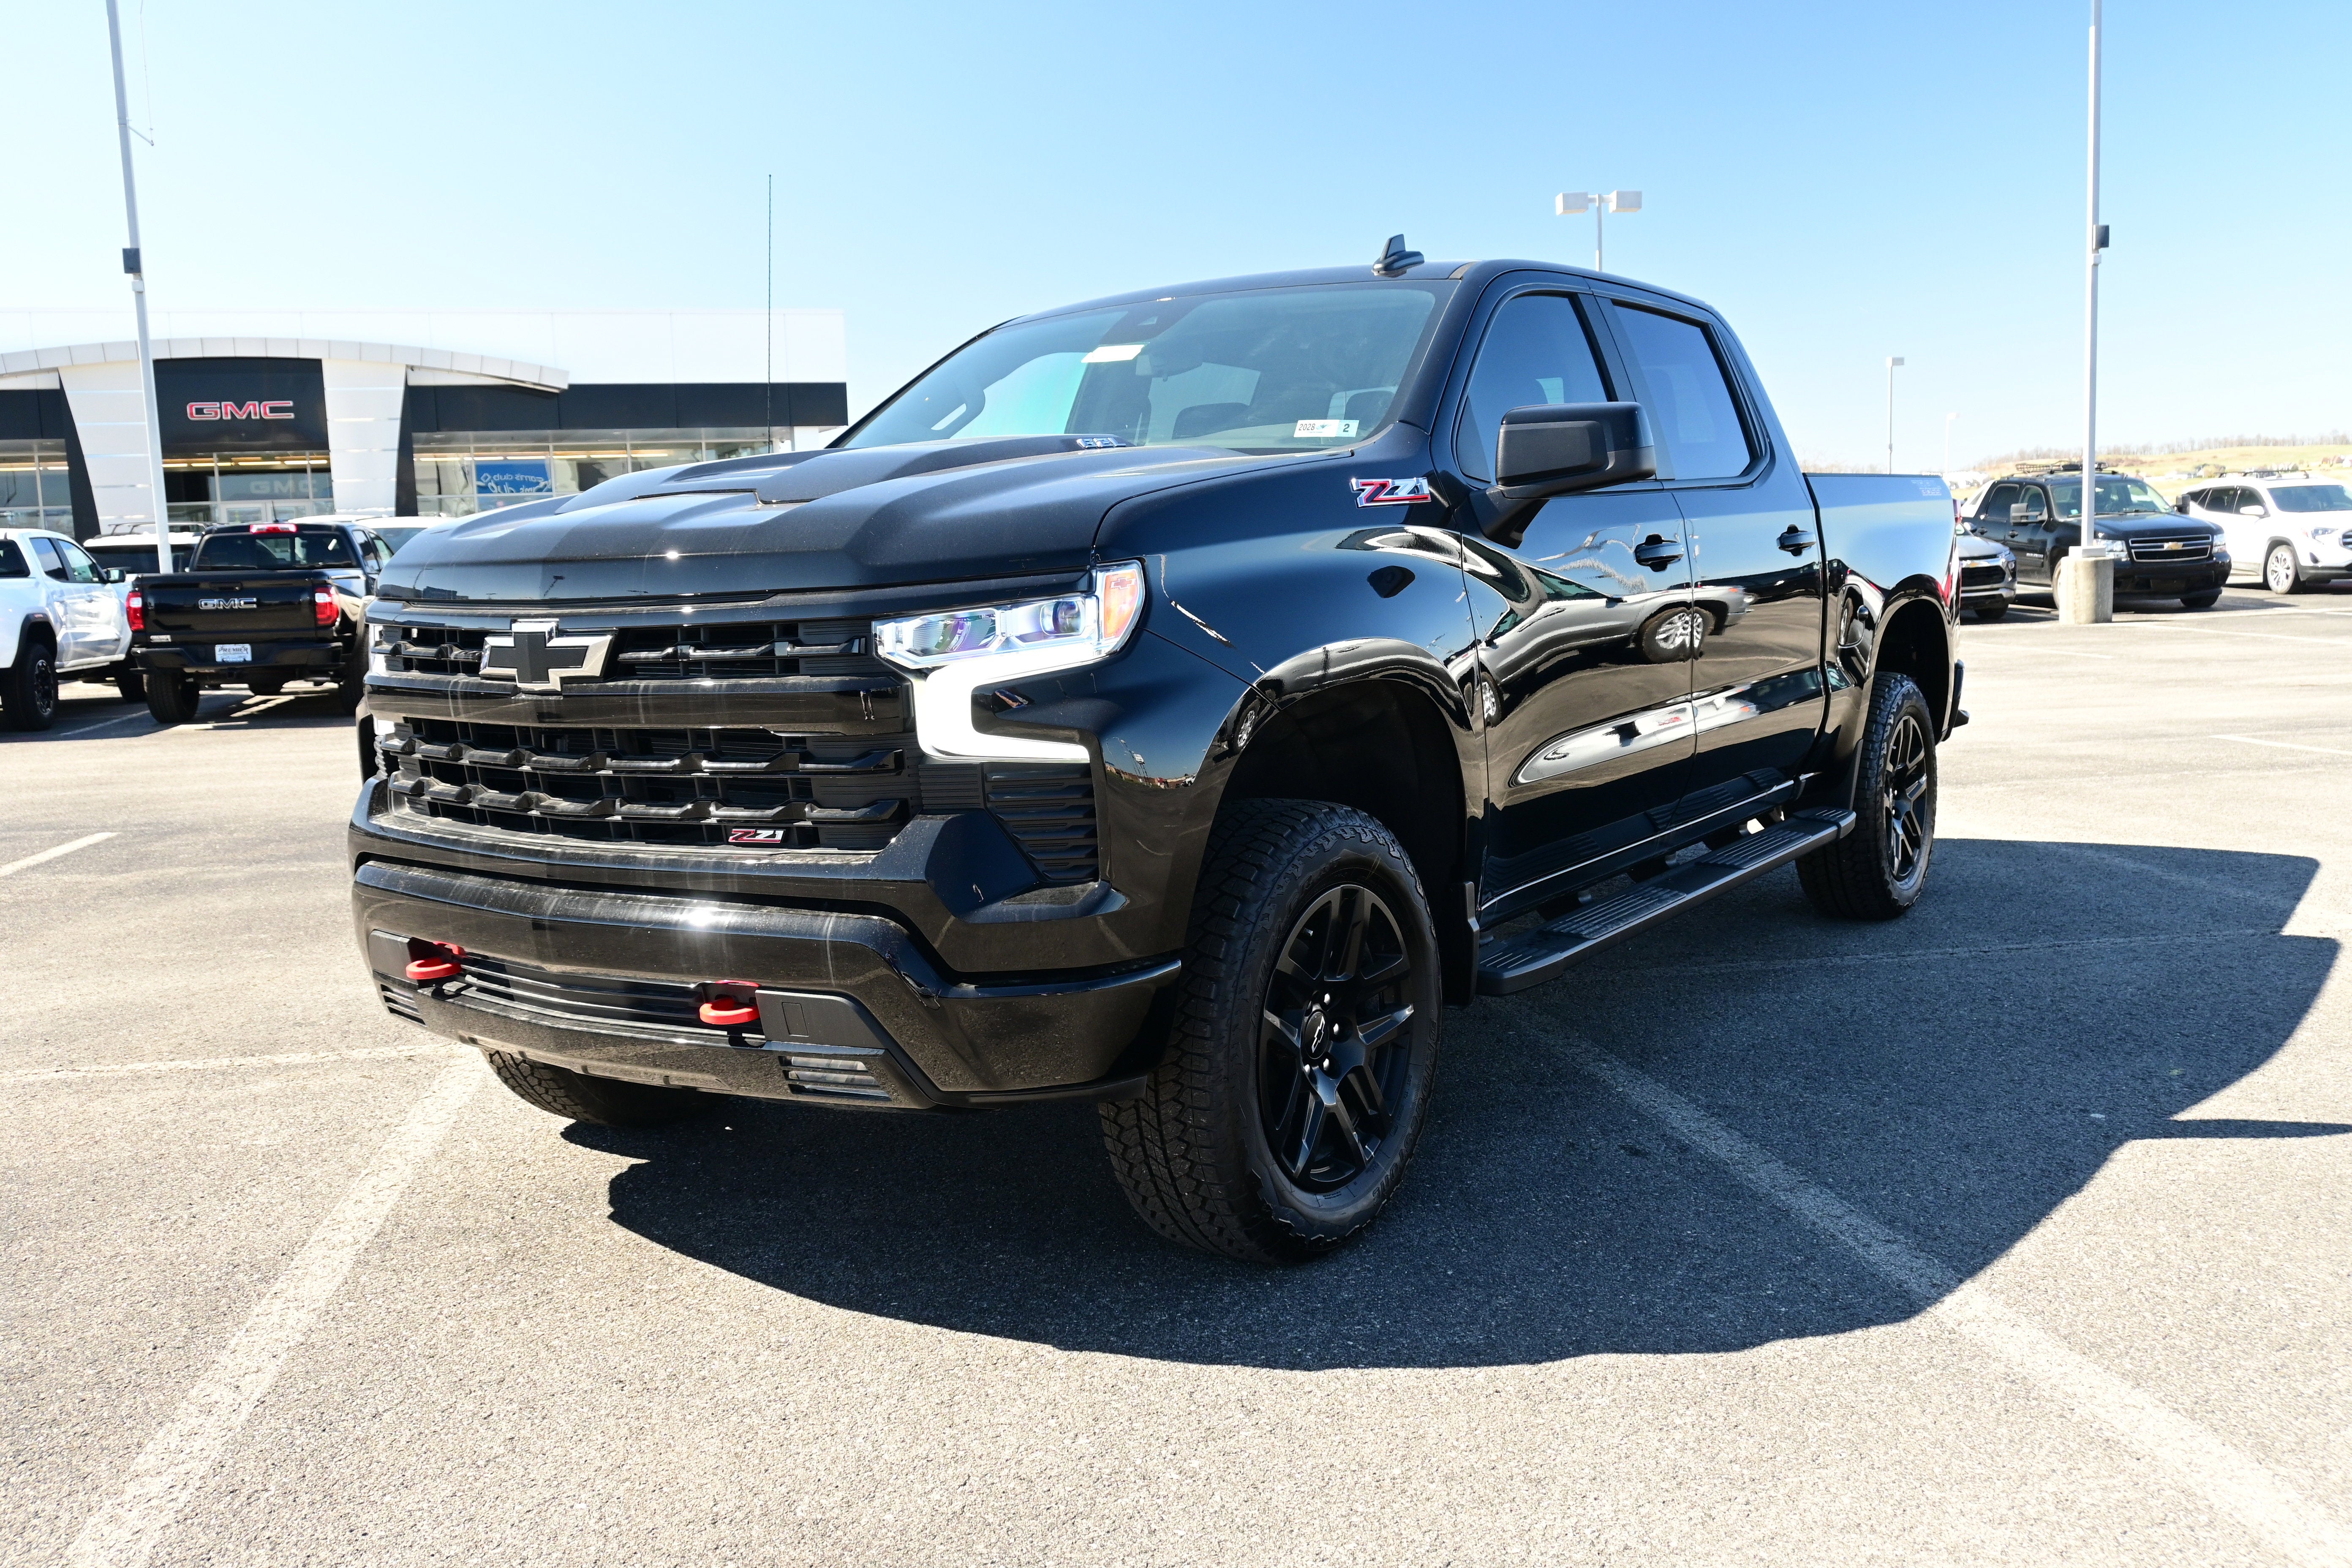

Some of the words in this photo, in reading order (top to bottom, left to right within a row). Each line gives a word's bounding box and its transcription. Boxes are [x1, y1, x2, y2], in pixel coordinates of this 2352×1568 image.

[187, 400, 294, 421] GMC
[1342, 423, 1350, 432] 2
[1350, 477, 1432, 508] Z71
[198, 598, 257, 610] GMC
[728, 828, 784, 843] Z71
[1372, 1017, 1437, 1206] BRIDGESTONE
